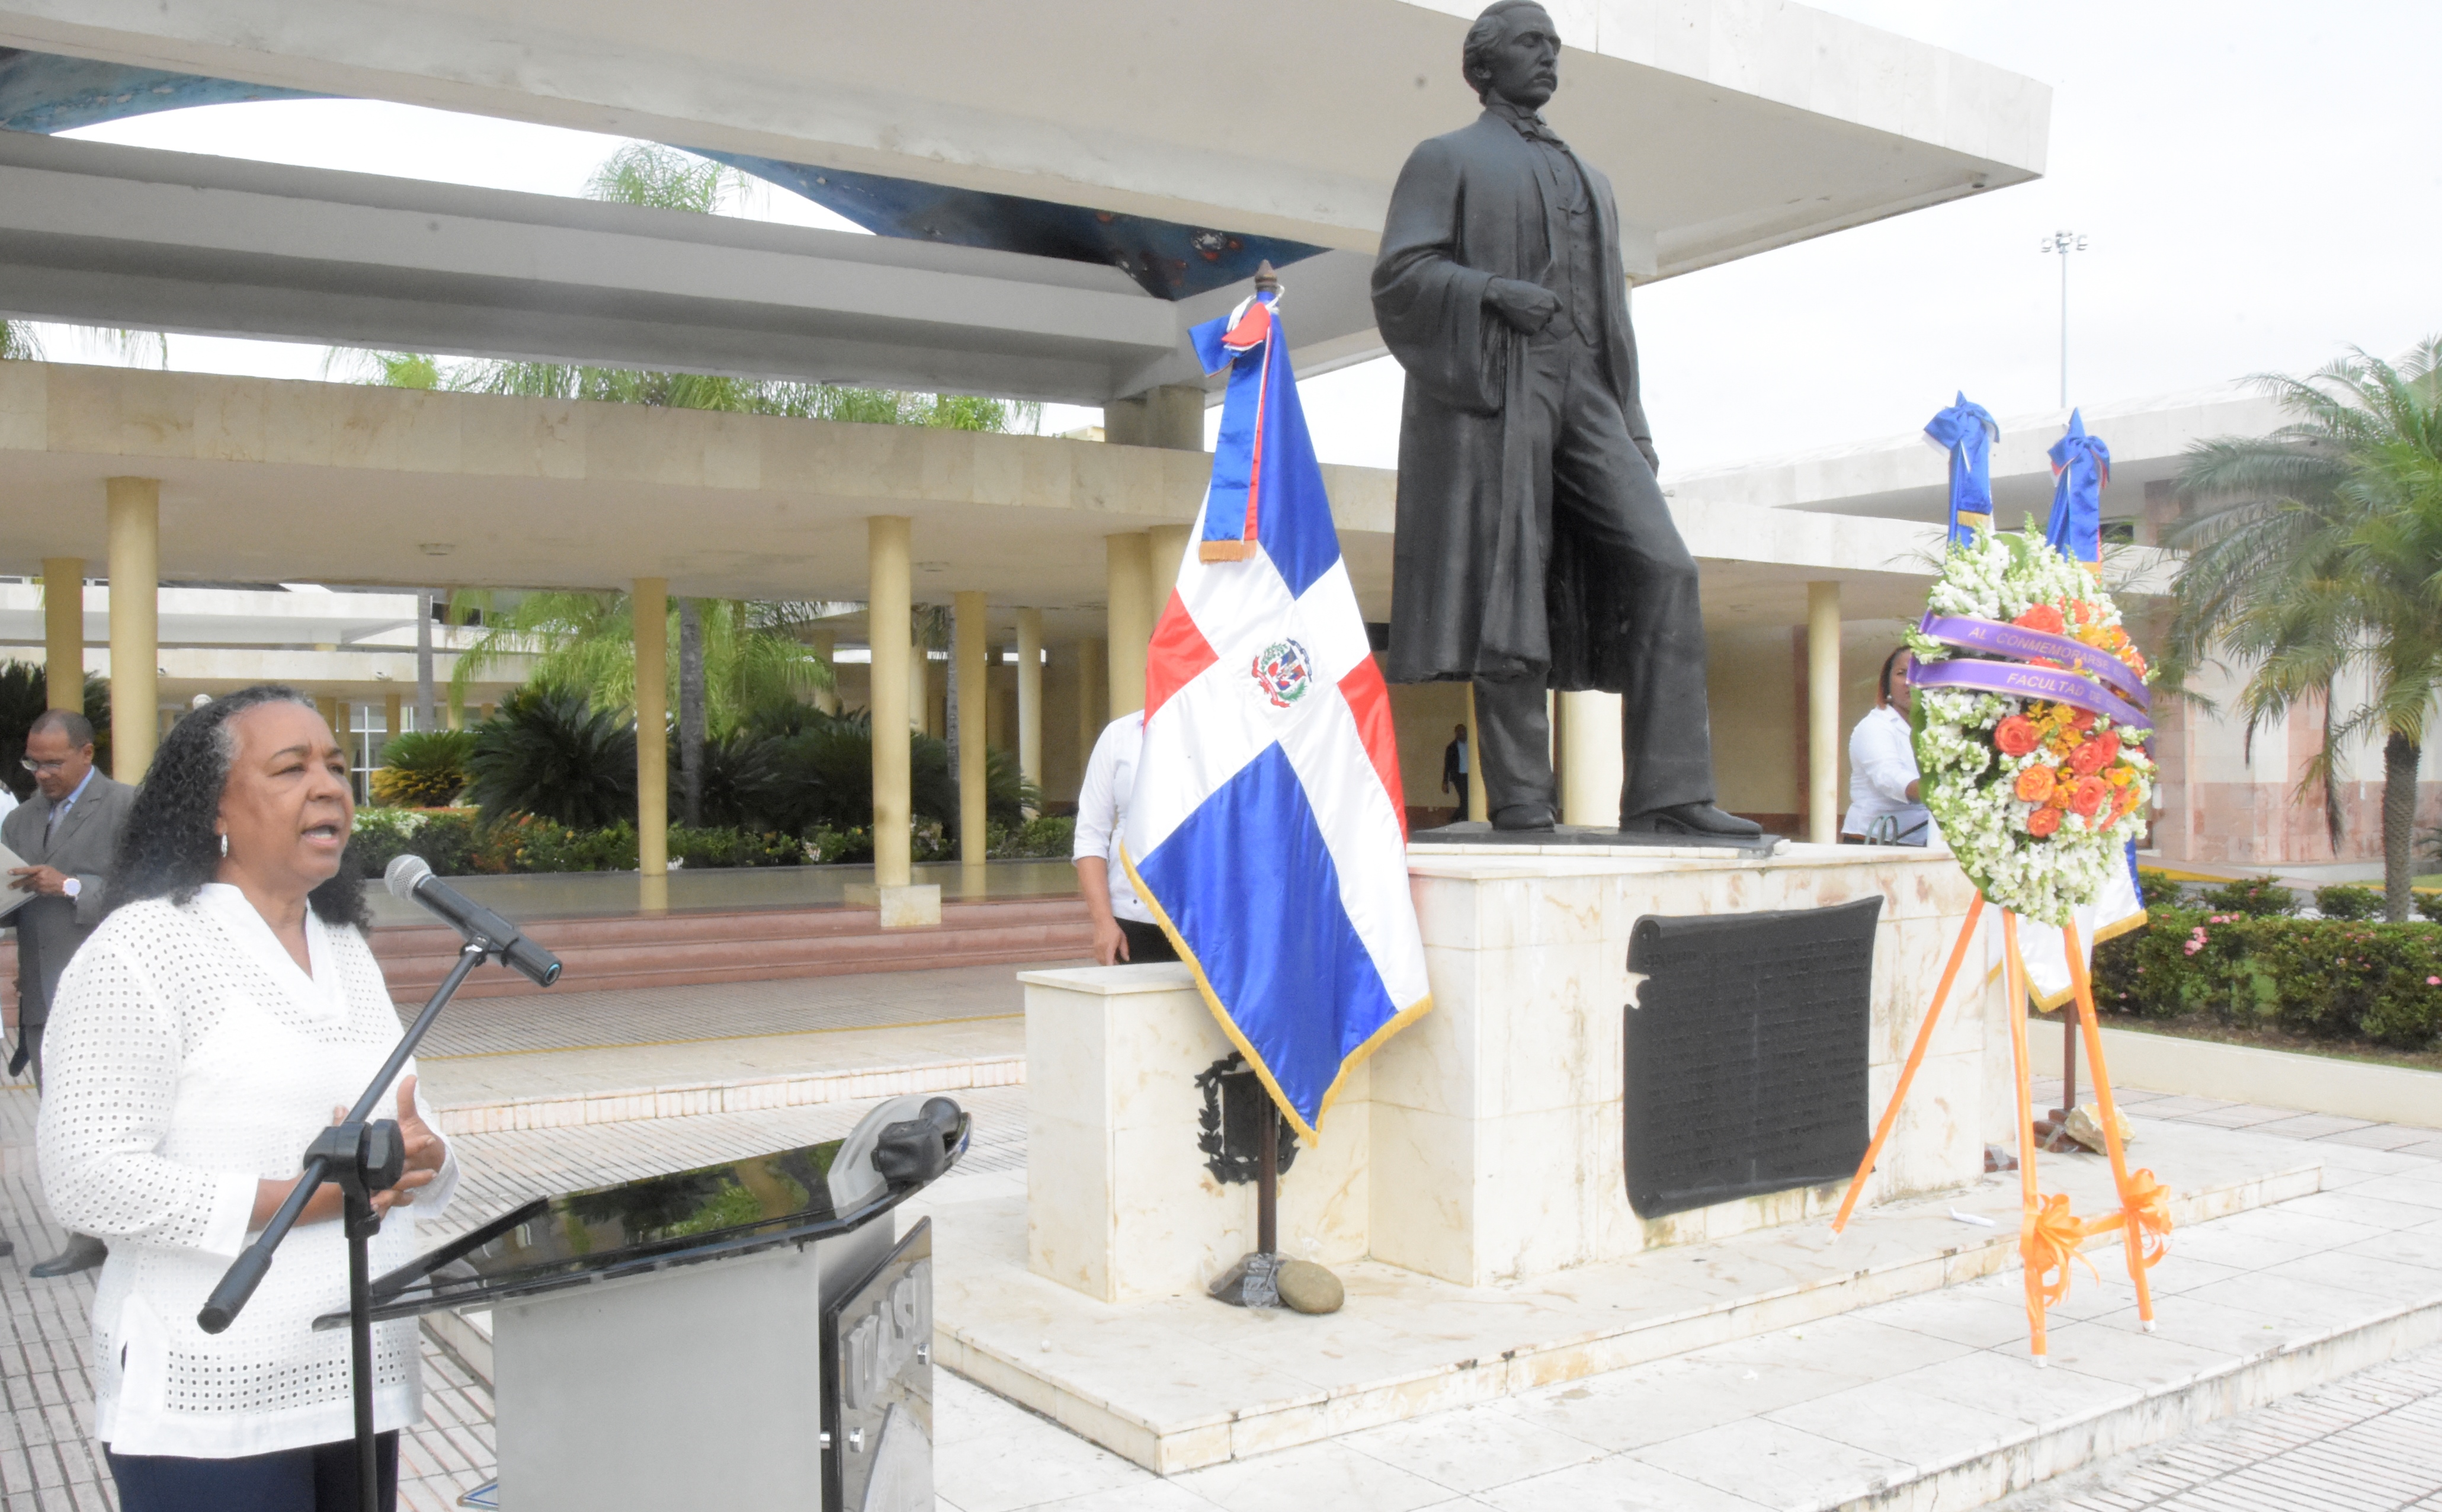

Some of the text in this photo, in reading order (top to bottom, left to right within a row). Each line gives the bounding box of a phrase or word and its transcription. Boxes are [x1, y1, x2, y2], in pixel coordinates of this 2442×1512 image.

[1967, 626, 2109, 671] AL CONMEMORARSE
[2006, 672, 2102, 704] FACULTAD DE
